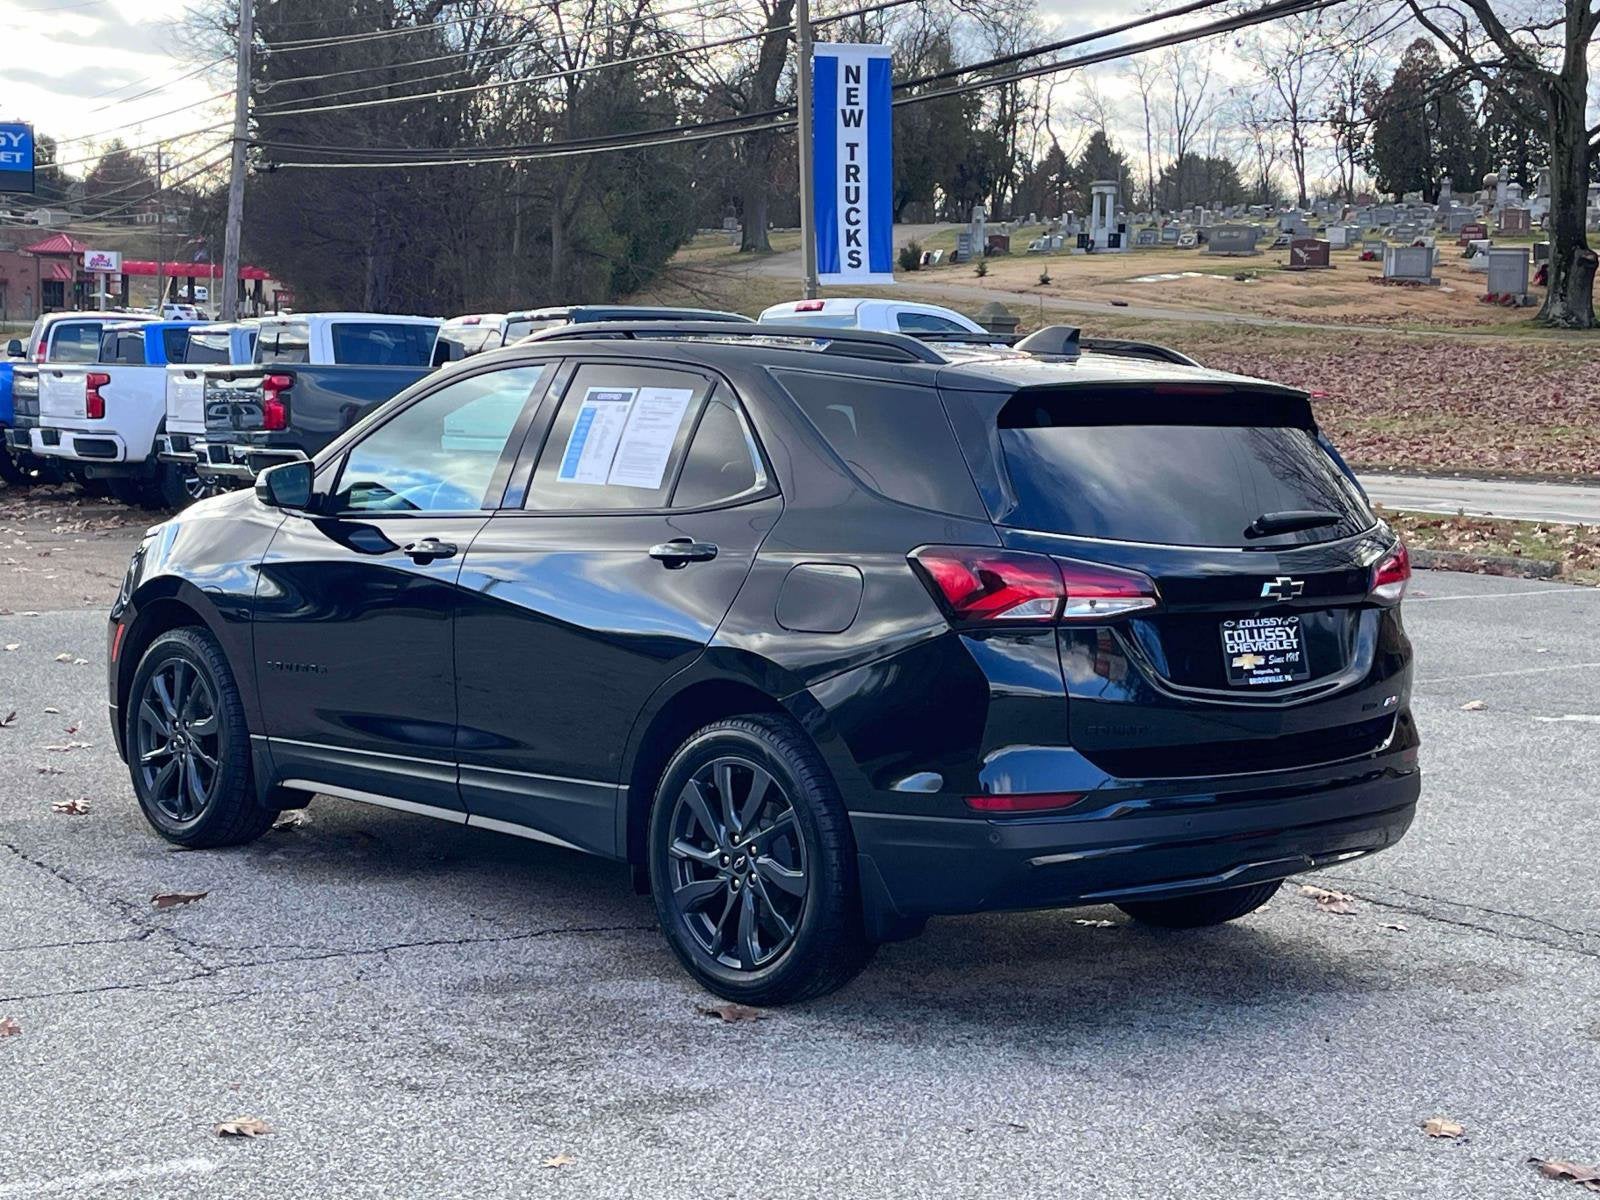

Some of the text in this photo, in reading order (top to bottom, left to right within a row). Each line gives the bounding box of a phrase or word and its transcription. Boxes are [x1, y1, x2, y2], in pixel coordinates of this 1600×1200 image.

[0, 151, 24, 163] ET
[841, 65, 864, 269] NEW TRUCKS
[1224, 626, 1297, 643] COLUSSY
[1226, 639, 1299, 653] CHEVROLET
